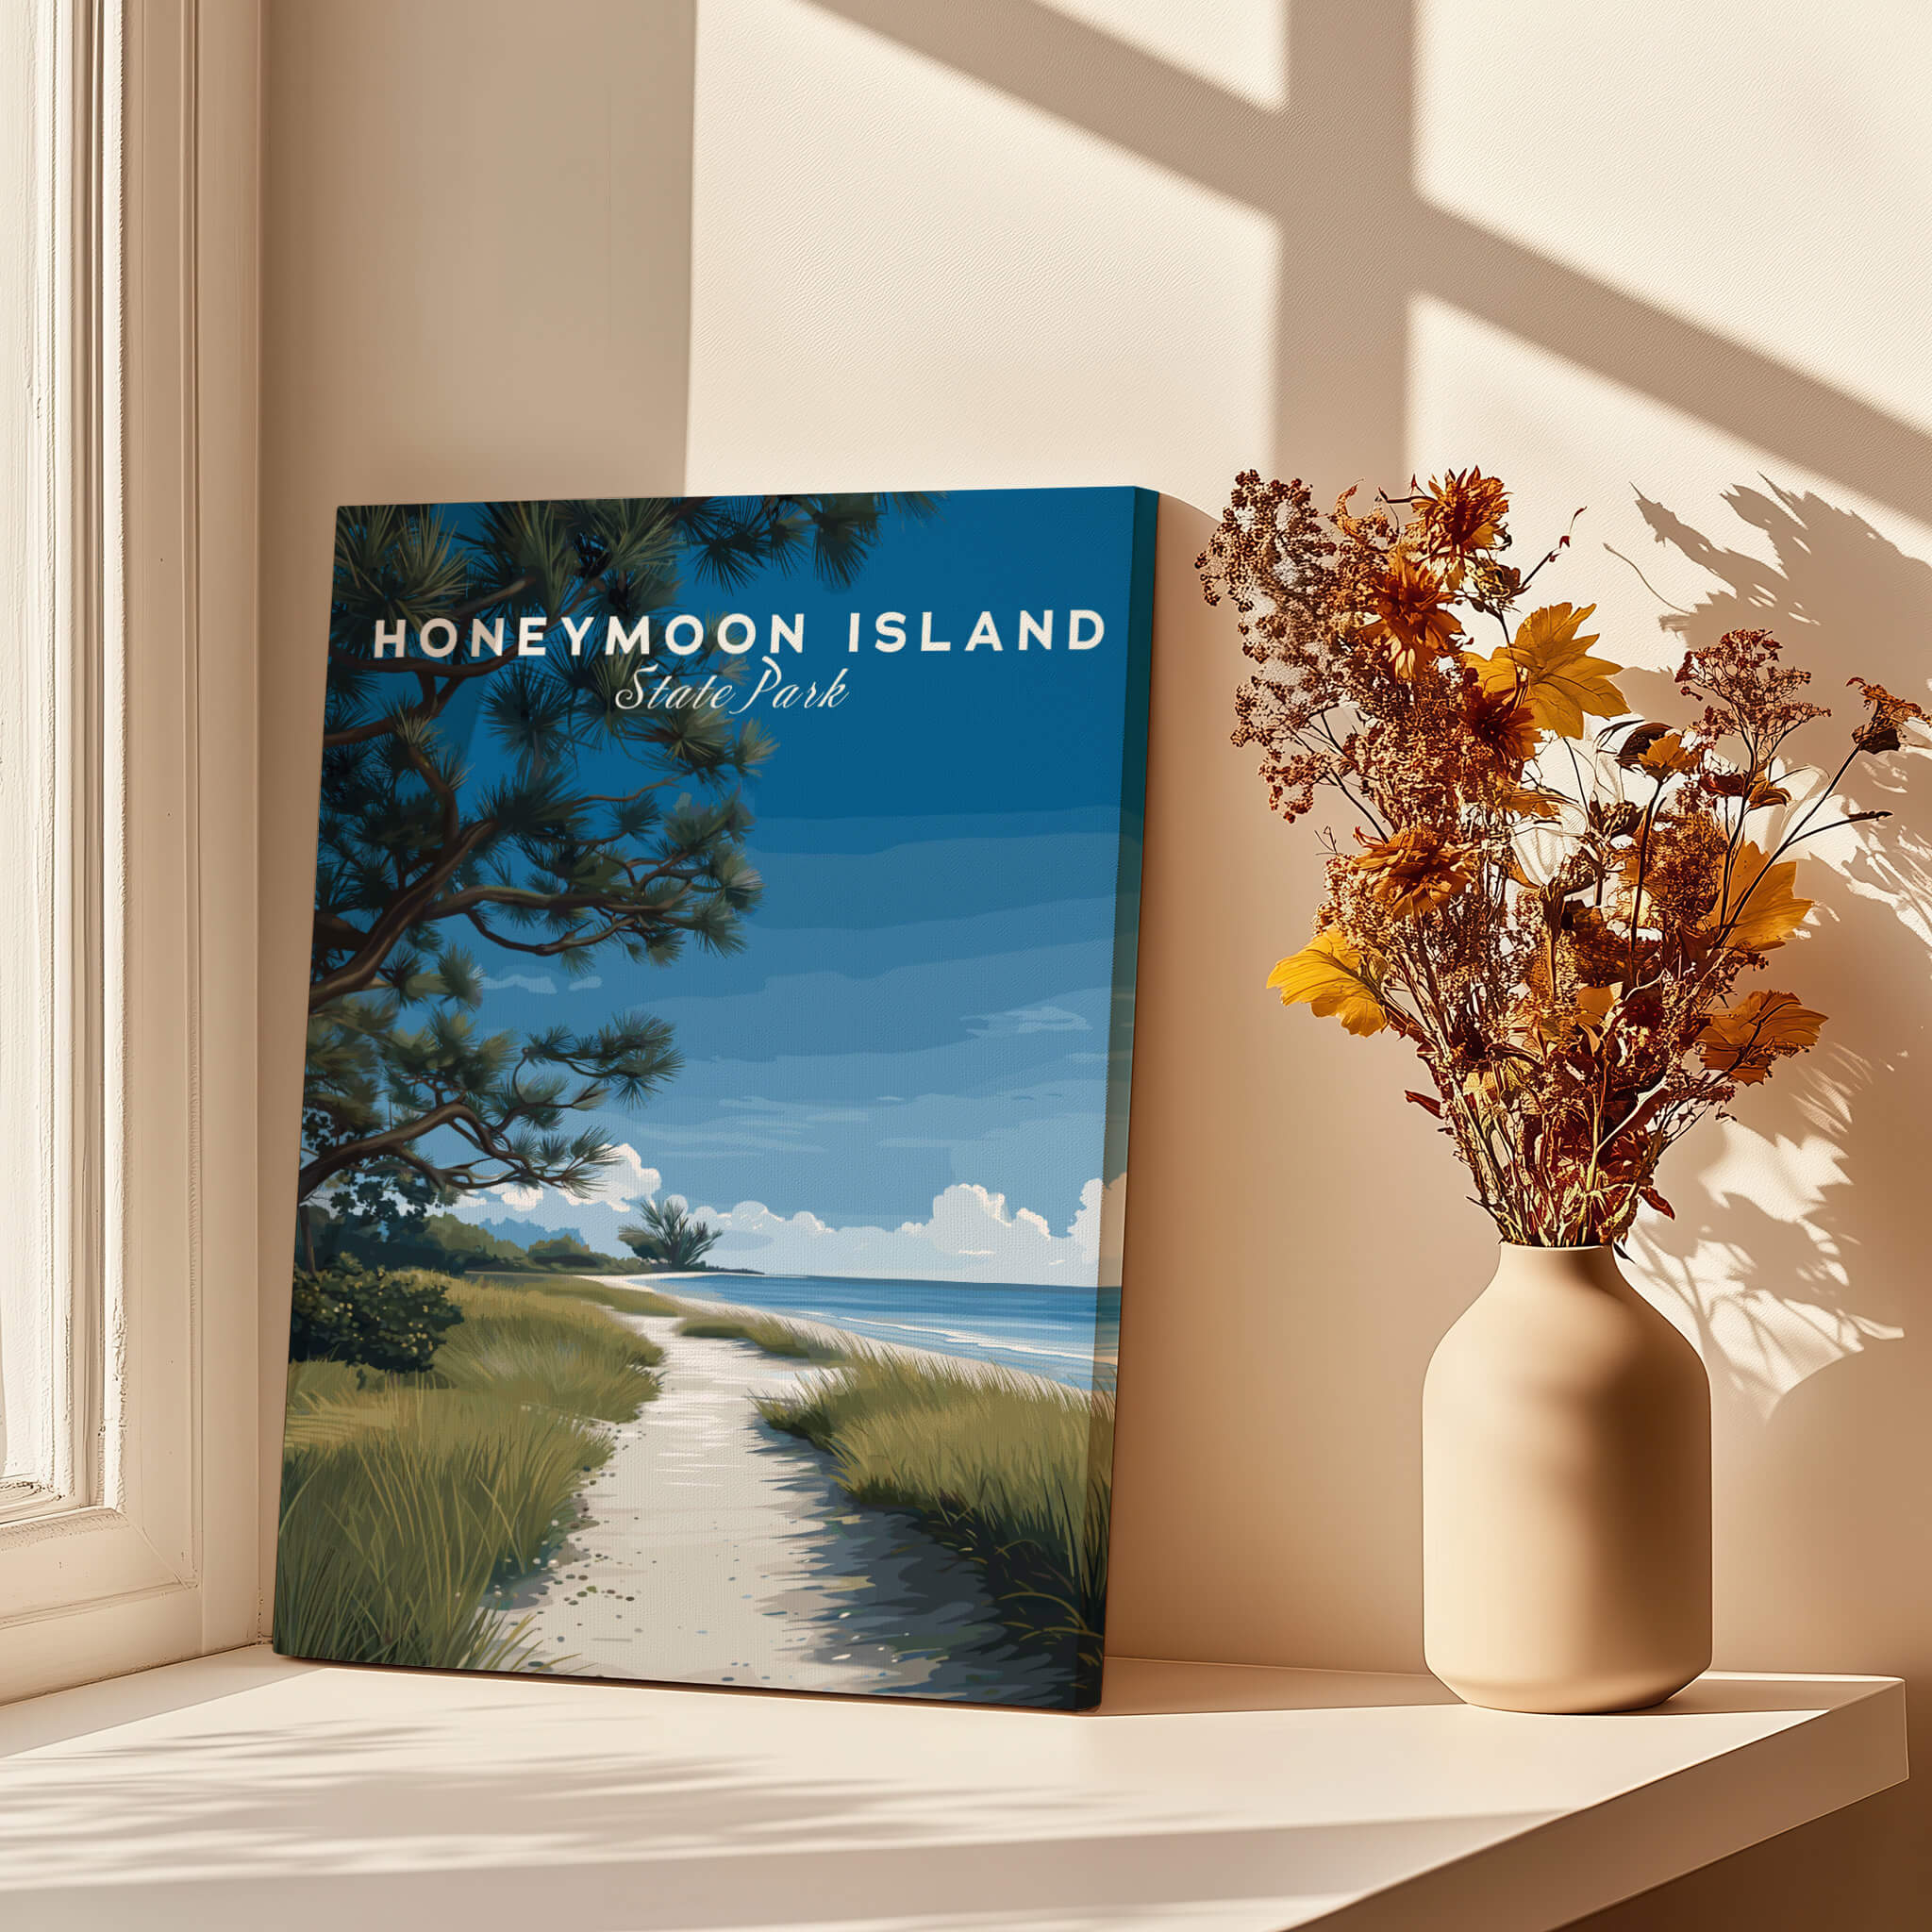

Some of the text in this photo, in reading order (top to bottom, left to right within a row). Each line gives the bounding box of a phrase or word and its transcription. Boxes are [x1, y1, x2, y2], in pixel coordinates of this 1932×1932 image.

[374, 609, 1106, 658] HONEYMOON ISLAND
[615, 656, 850, 714] State Park
